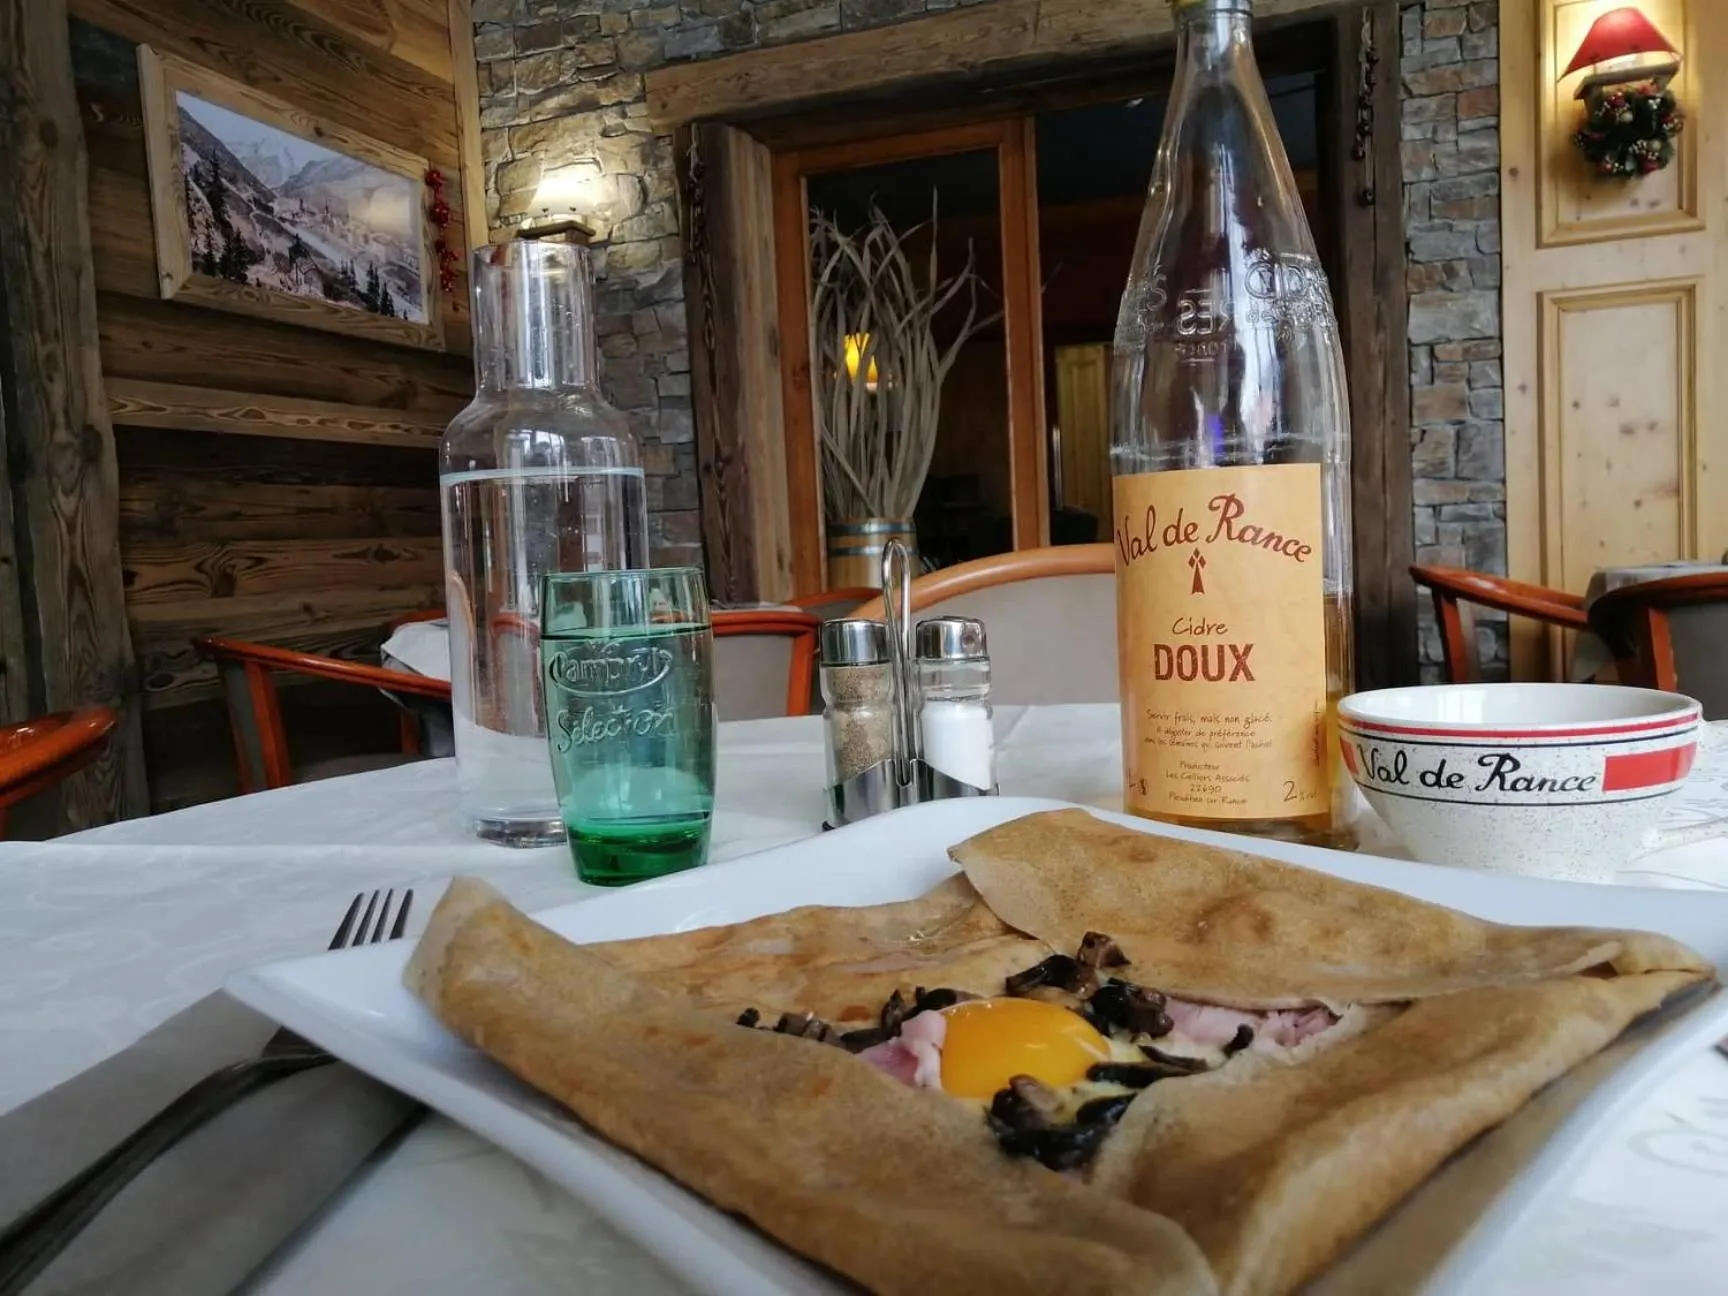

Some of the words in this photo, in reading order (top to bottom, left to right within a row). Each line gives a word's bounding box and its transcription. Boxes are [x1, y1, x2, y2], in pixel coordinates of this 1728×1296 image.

[1117, 504, 1157, 566] Val
[1162, 507, 1200, 547] de
[1205, 493, 1312, 563] Rance
[1171, 616, 1228, 636] Cidre
[1153, 643, 1256, 682] DOUX
[1225, 715, 1240, 724] non
[1356, 743, 1410, 785] Val
[1420, 758, 1464, 790] de
[1475, 753, 1599, 792] Rance
